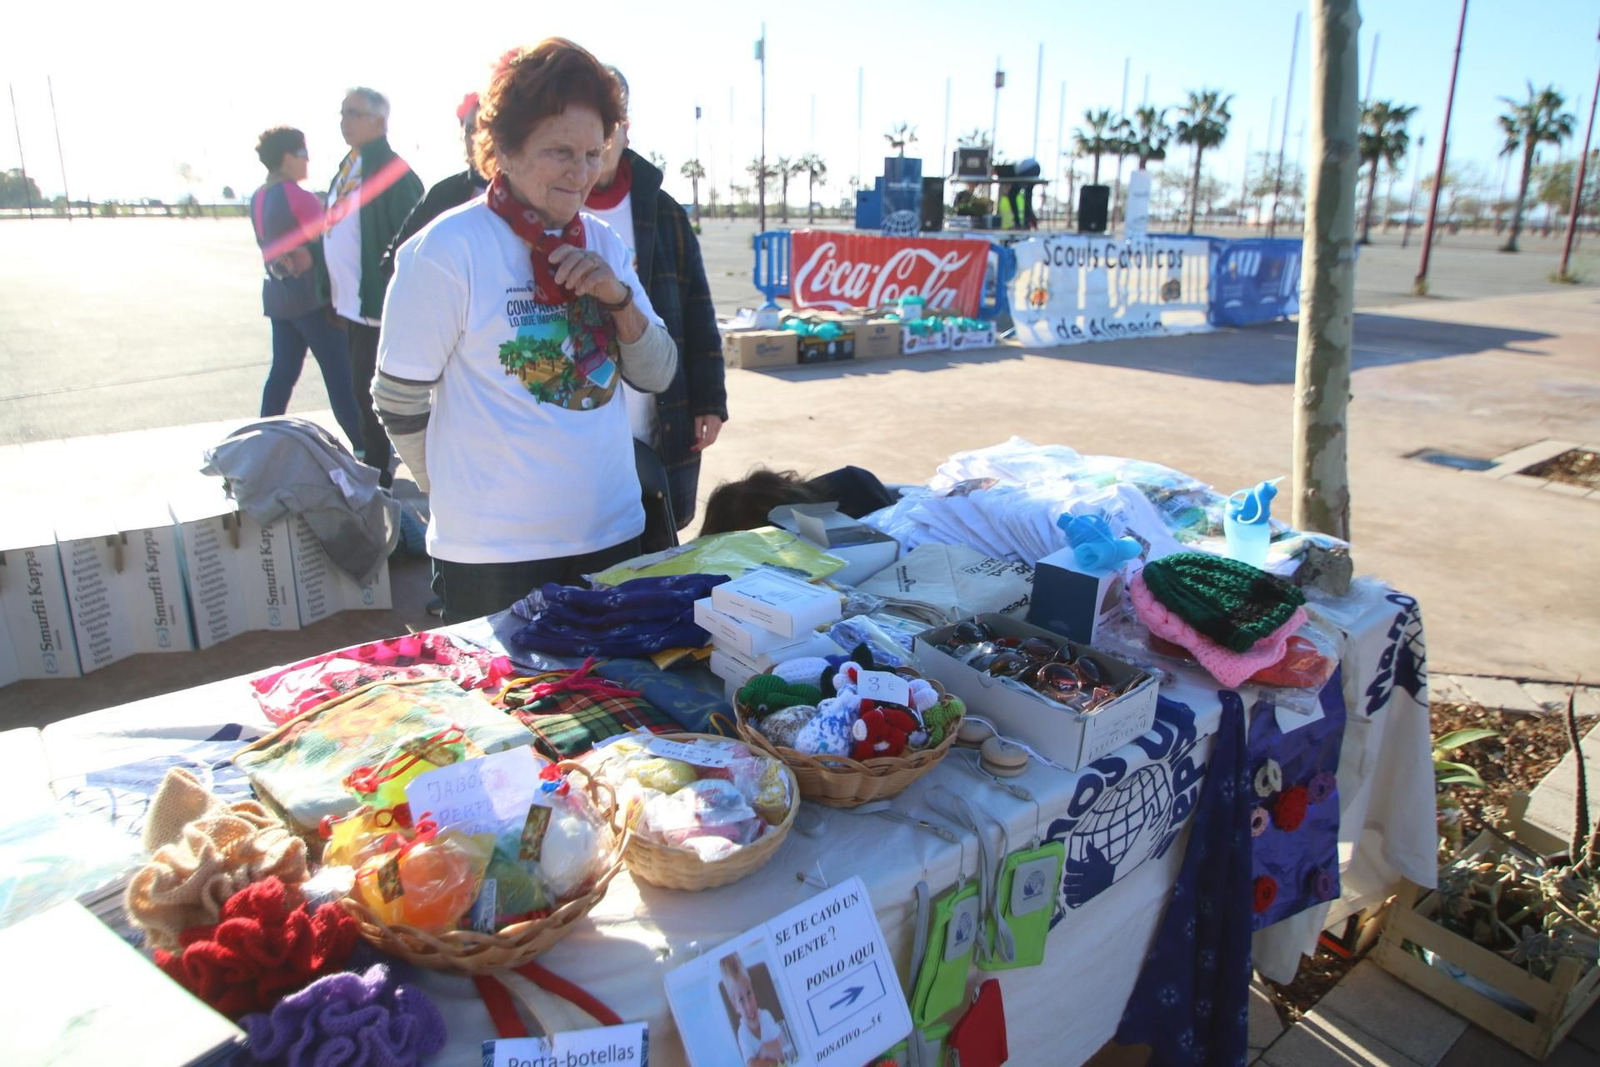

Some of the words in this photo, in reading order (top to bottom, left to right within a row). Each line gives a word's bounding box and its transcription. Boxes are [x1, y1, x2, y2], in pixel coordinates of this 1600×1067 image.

[1043, 240, 1099, 267] Scouts
[794, 242, 973, 309] Coca-Cola
[509, 317, 520, 328] LO
[520, 315, 536, 326] QUE
[1056, 318, 1083, 340] de
[142, 530, 161, 577] Kappa
[25, 550, 43, 596] Kappa
[263, 562, 279, 607] Smurfit
[149, 578, 168, 626] Smurfit
[31, 596, 55, 652] Smurfit
[868, 677, 880, 691] 3
[775, 926, 791, 946] SE
[792, 916, 809, 935] TE
[810, 898, 841, 926] CAYÓ
[843, 892, 860, 909] UN
[783, 934, 828, 968] DIENTE
[806, 958, 845, 992] PONLO
[508, 1044, 635, 1067] Porta-botellas
[816, 1028, 861, 1063] DONATIVO
